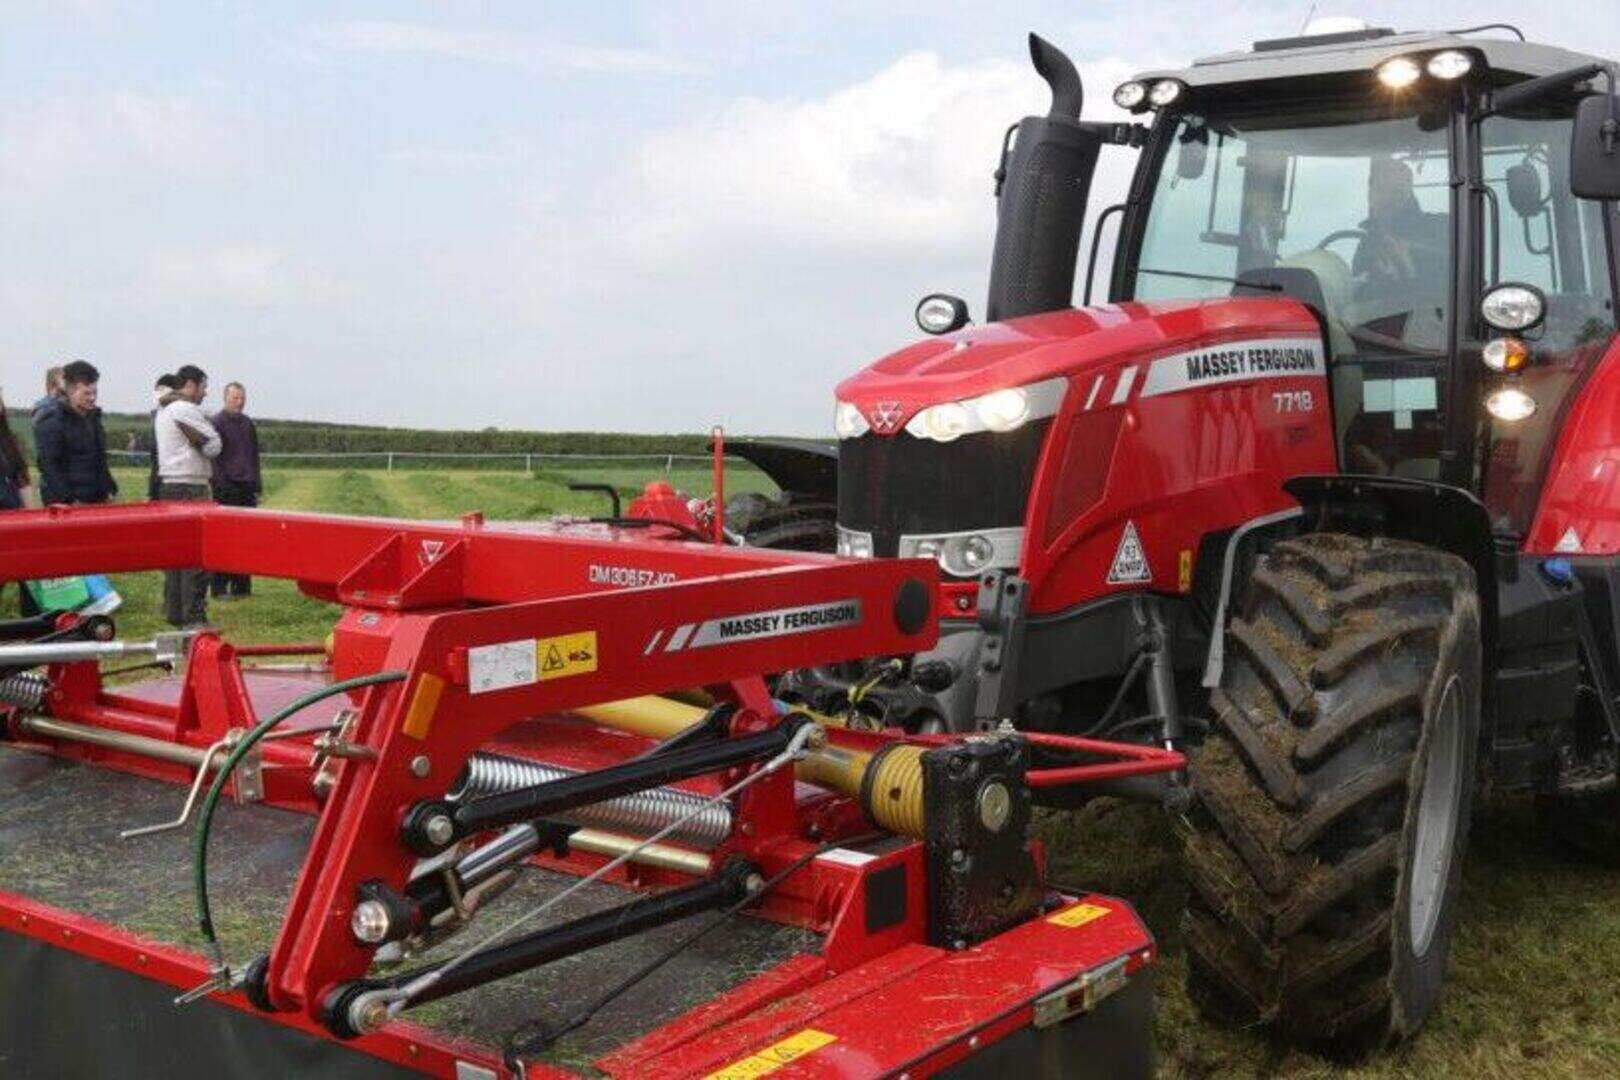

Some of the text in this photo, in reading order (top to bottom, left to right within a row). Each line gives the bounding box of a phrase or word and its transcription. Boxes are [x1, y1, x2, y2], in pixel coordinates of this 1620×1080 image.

[1186, 348, 1316, 381] MASSEY FERGUSON
[1272, 390, 1313, 413] 7718
[719, 604, 856, 638] MASSEY FERGUSON
